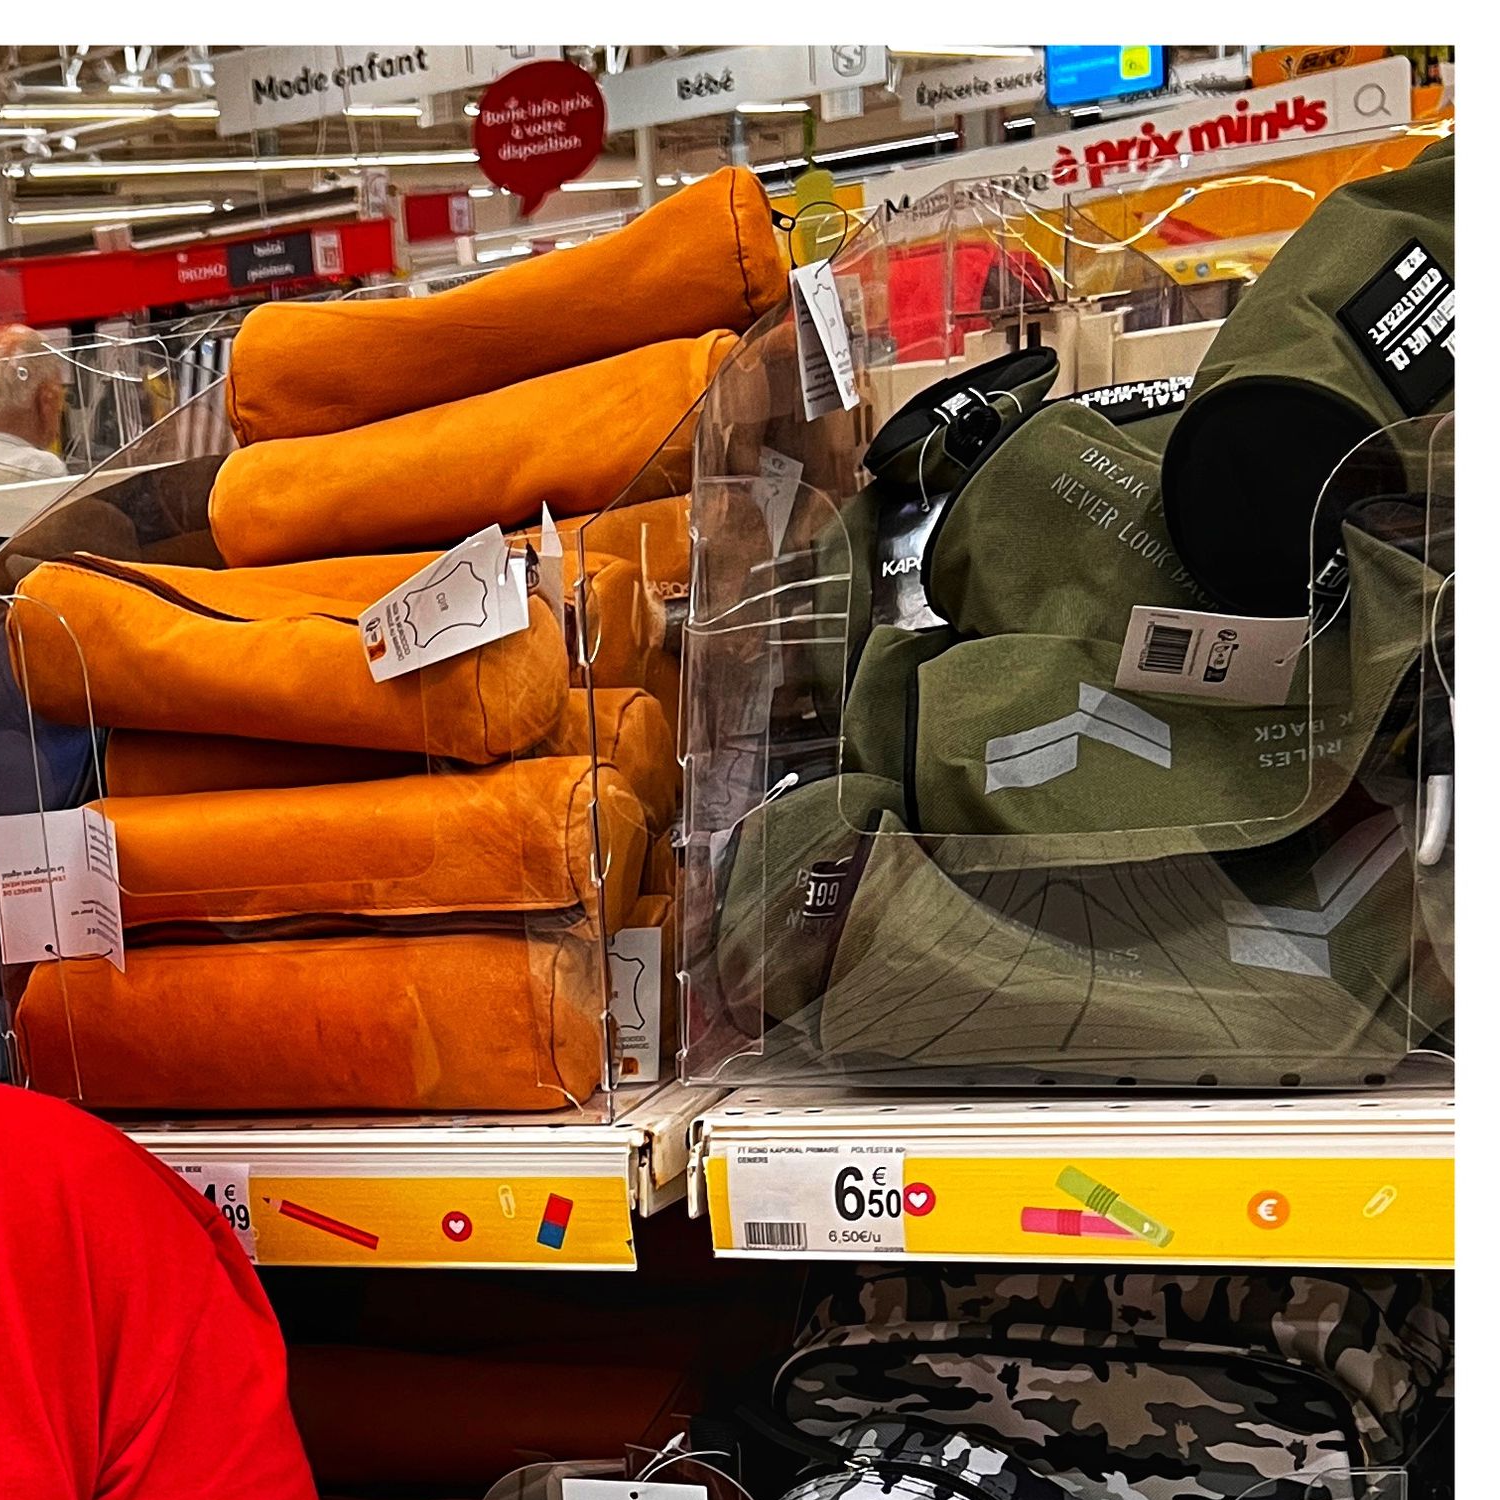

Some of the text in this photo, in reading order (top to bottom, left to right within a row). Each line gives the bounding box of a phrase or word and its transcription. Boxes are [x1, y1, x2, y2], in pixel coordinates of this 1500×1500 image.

[251, 46, 429, 105] Mode enfant
[1051, 146, 1080, 186] à
[1083, 122, 1184, 189] prix
[1187, 96, 1328, 153] minus
[1079, 446, 1150, 499] BREAK
[1050, 473, 1120, 530] NEVER
[1118, 521, 1174, 569] LOOK
[834, 1166, 902, 1222] 6 € 50
[828, 1230, 882, 1244] 6,50€/u
